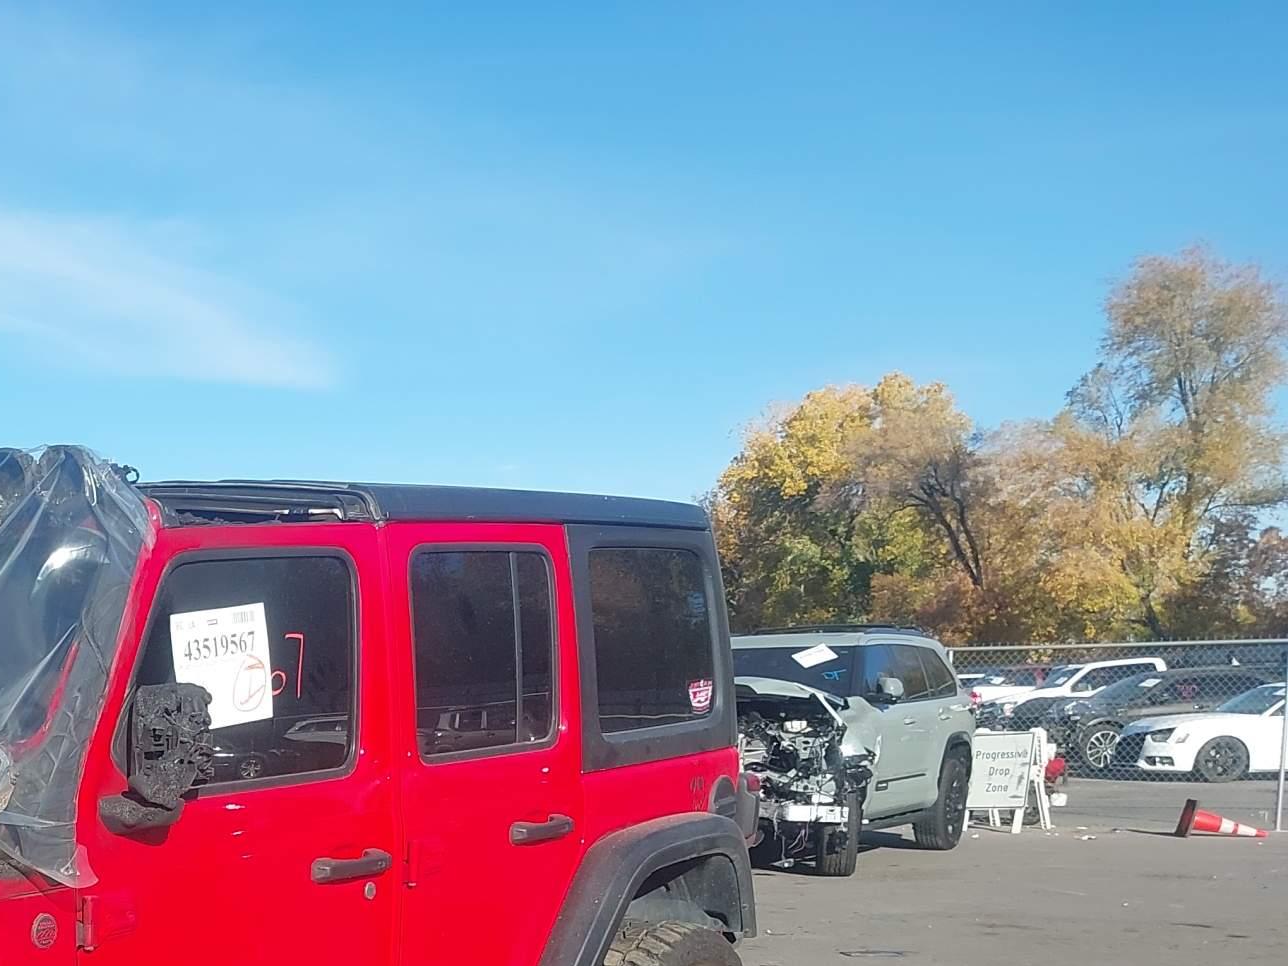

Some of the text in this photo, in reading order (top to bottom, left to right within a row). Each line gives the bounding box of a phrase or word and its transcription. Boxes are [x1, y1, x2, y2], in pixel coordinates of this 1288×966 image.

[183, 630, 257, 662] 43519567
[975, 750, 1029, 762] Progressive
[988, 766, 1011, 777] Drop
[985, 782, 1009, 793] Zone
